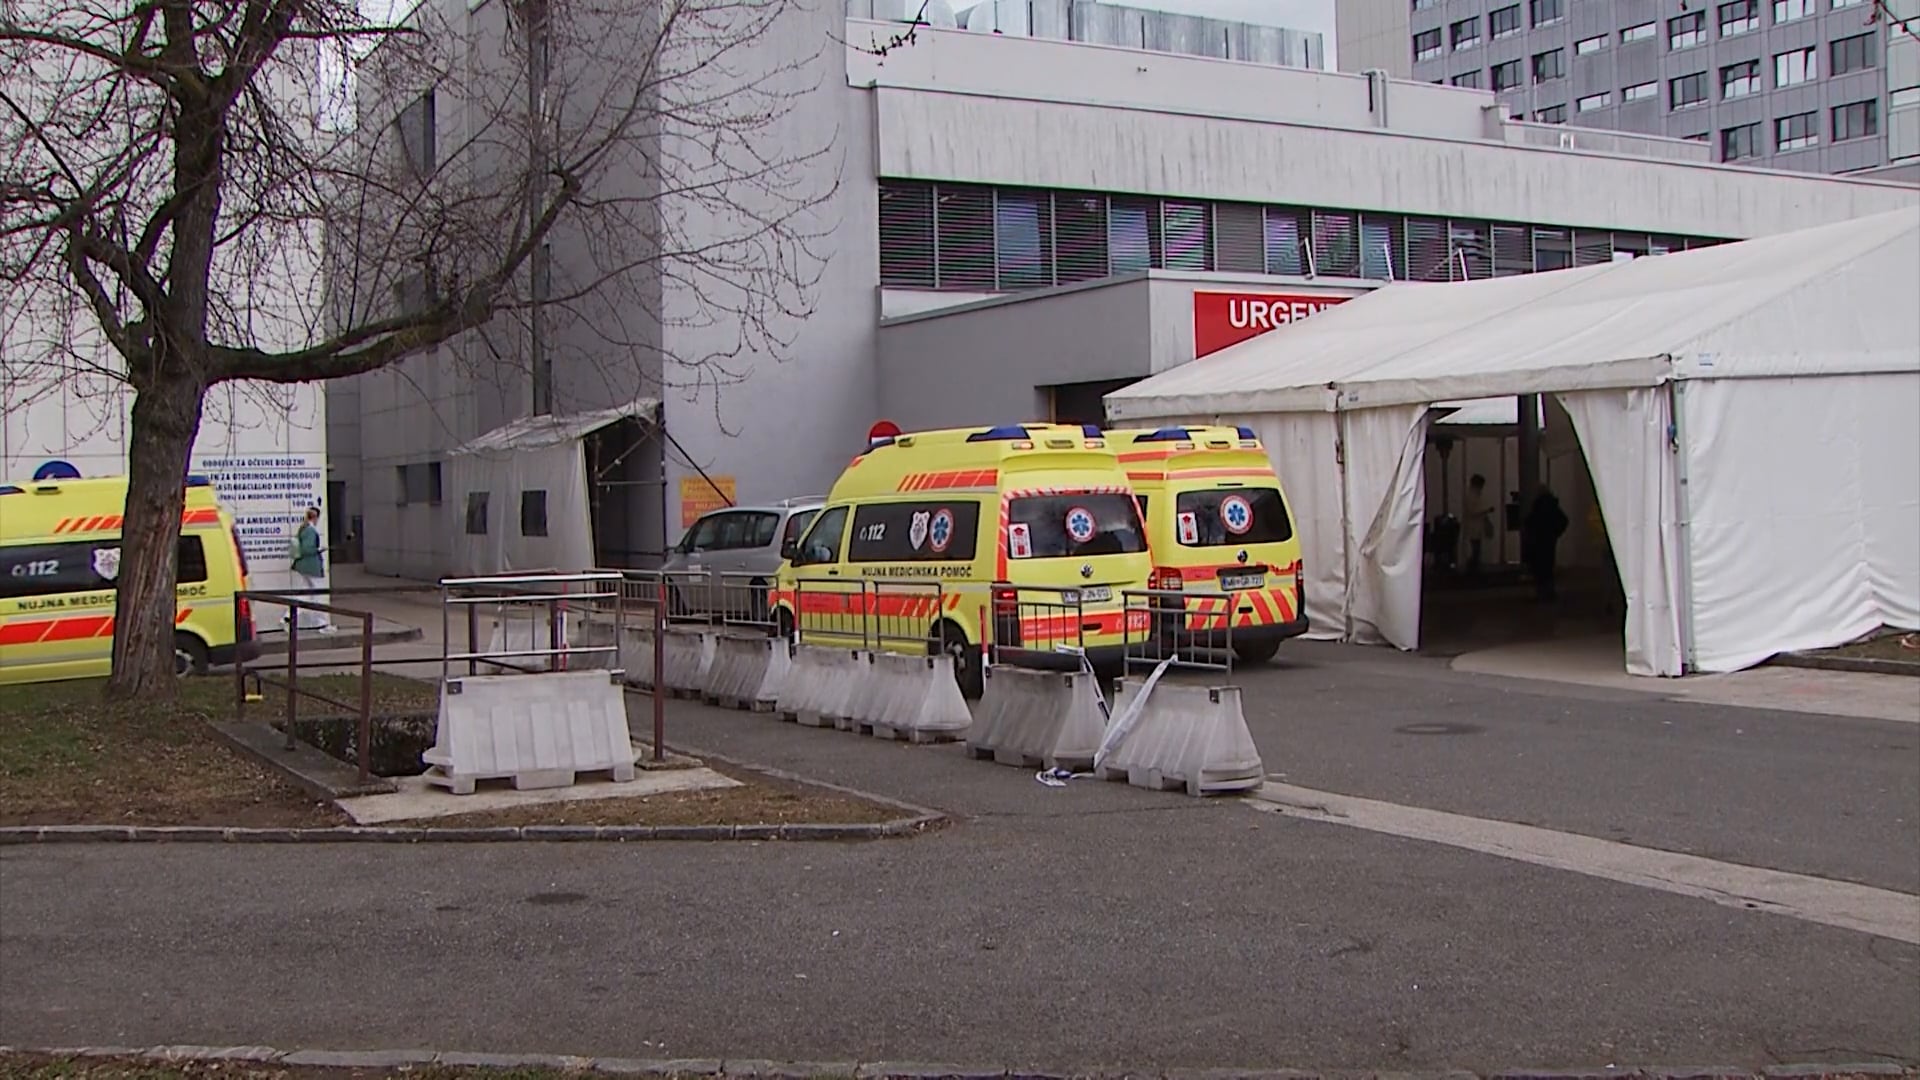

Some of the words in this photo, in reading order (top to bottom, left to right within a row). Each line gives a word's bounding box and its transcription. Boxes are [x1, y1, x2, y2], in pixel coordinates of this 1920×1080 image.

[1229, 300, 1327, 329] URGEN
[237, 459, 246, 467] ZA
[221, 473, 231, 481] ZA
[867, 523, 886, 541] 112
[28, 560, 60, 576] 112
[862, 567, 886, 577] NUJNA
[889, 567, 938, 577] MEDICINSKA
[941, 565, 972, 577] POMOČ
[18, 597, 65, 610] NUJNA
[70, 594, 116, 606] MEDICI
